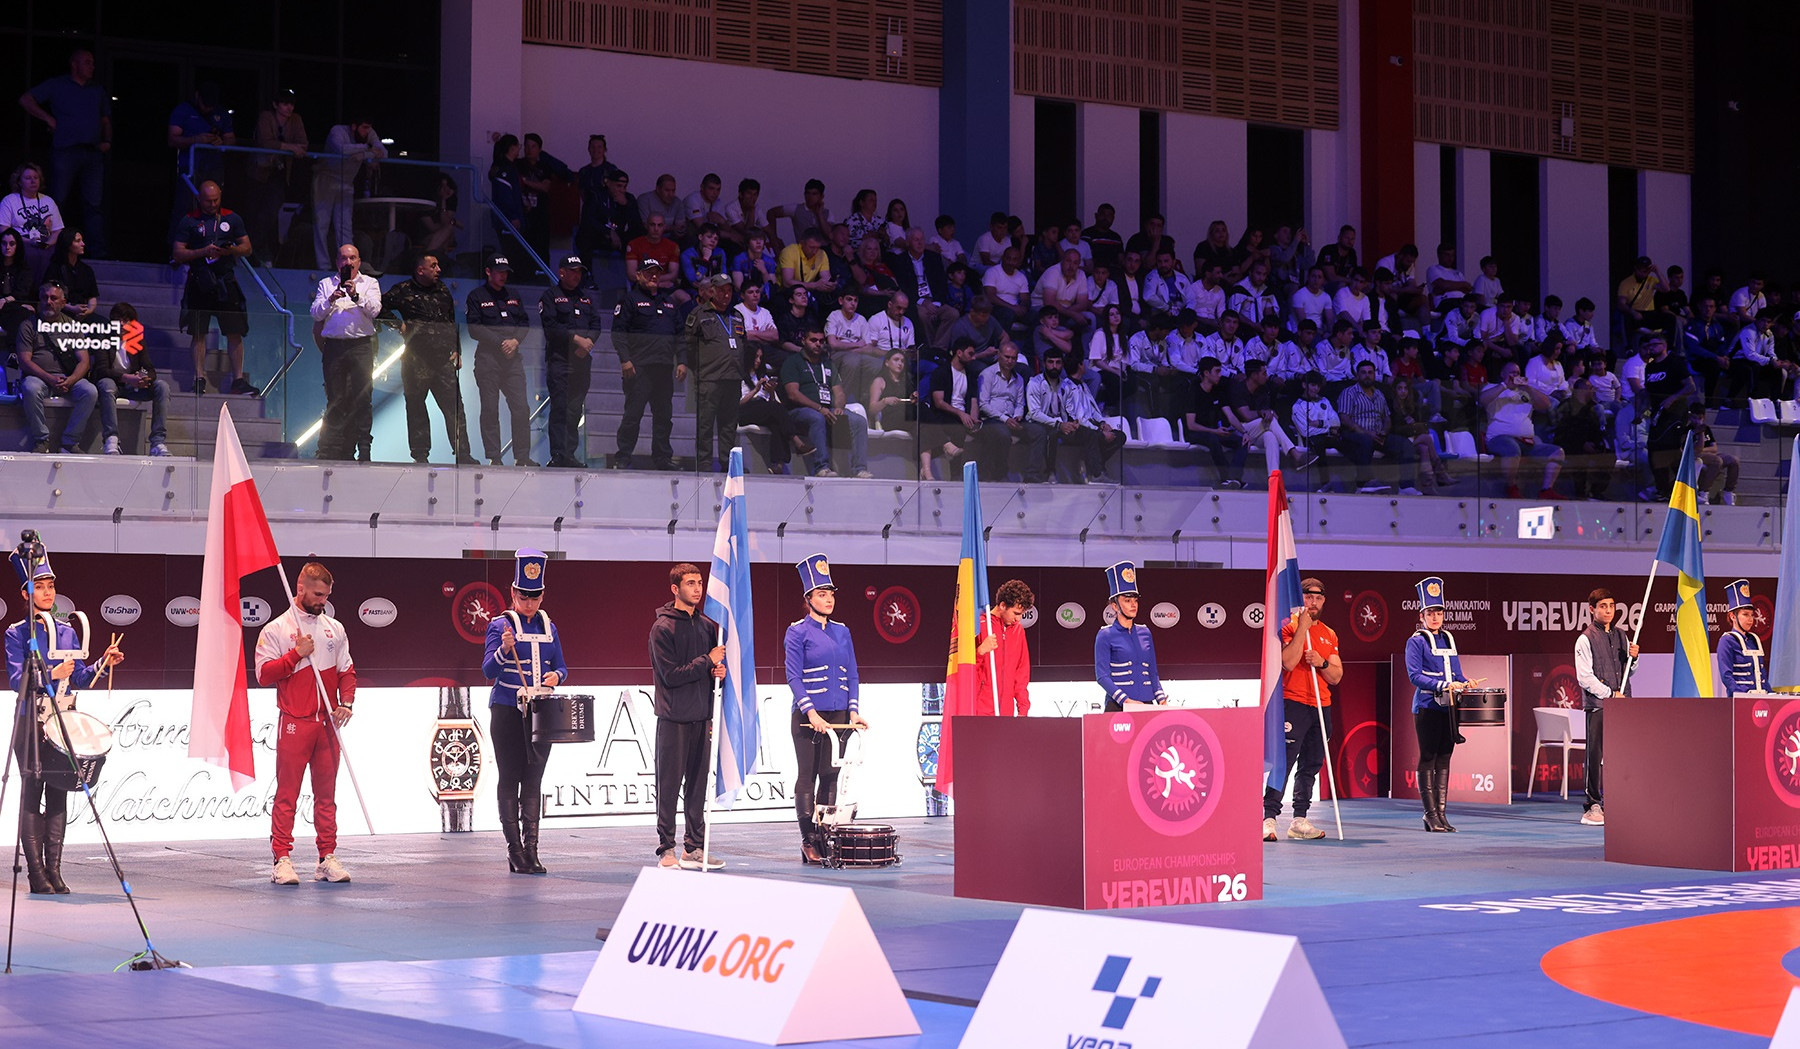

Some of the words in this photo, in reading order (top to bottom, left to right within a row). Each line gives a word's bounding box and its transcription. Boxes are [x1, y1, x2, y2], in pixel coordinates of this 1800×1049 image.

[104, 606, 138, 614] TaiShan
[1445, 600, 1491, 610] PANKRATION
[1455, 611, 1473, 621] MMA
[1113, 723, 1131, 731] UWW
[1113, 857, 1162, 872] EUROPEAN
[1164, 852, 1236, 869] CHAMPIONSHIPS
[627, 921, 795, 983] UWW.ORG
